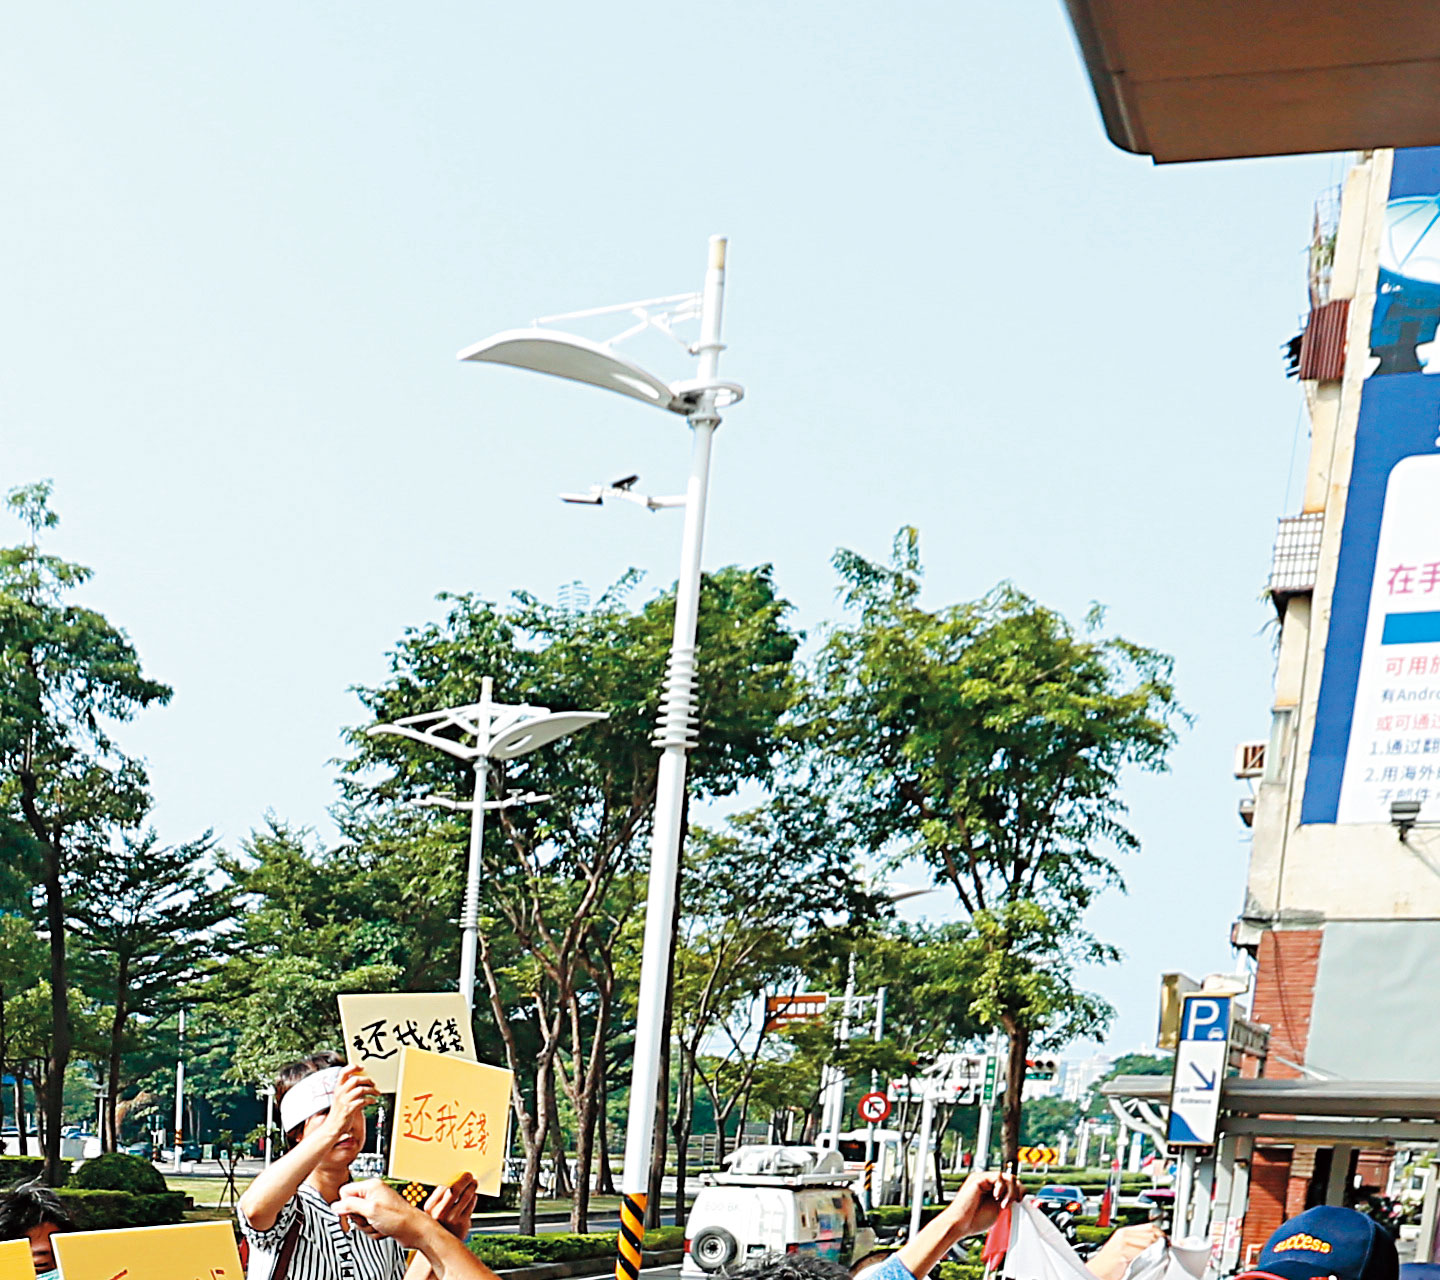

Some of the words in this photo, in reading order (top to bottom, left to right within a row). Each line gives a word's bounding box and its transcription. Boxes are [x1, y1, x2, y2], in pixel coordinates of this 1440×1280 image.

[1187, 1000, 1220, 1040] P
[403, 1093, 490, 1155] 还我錢
